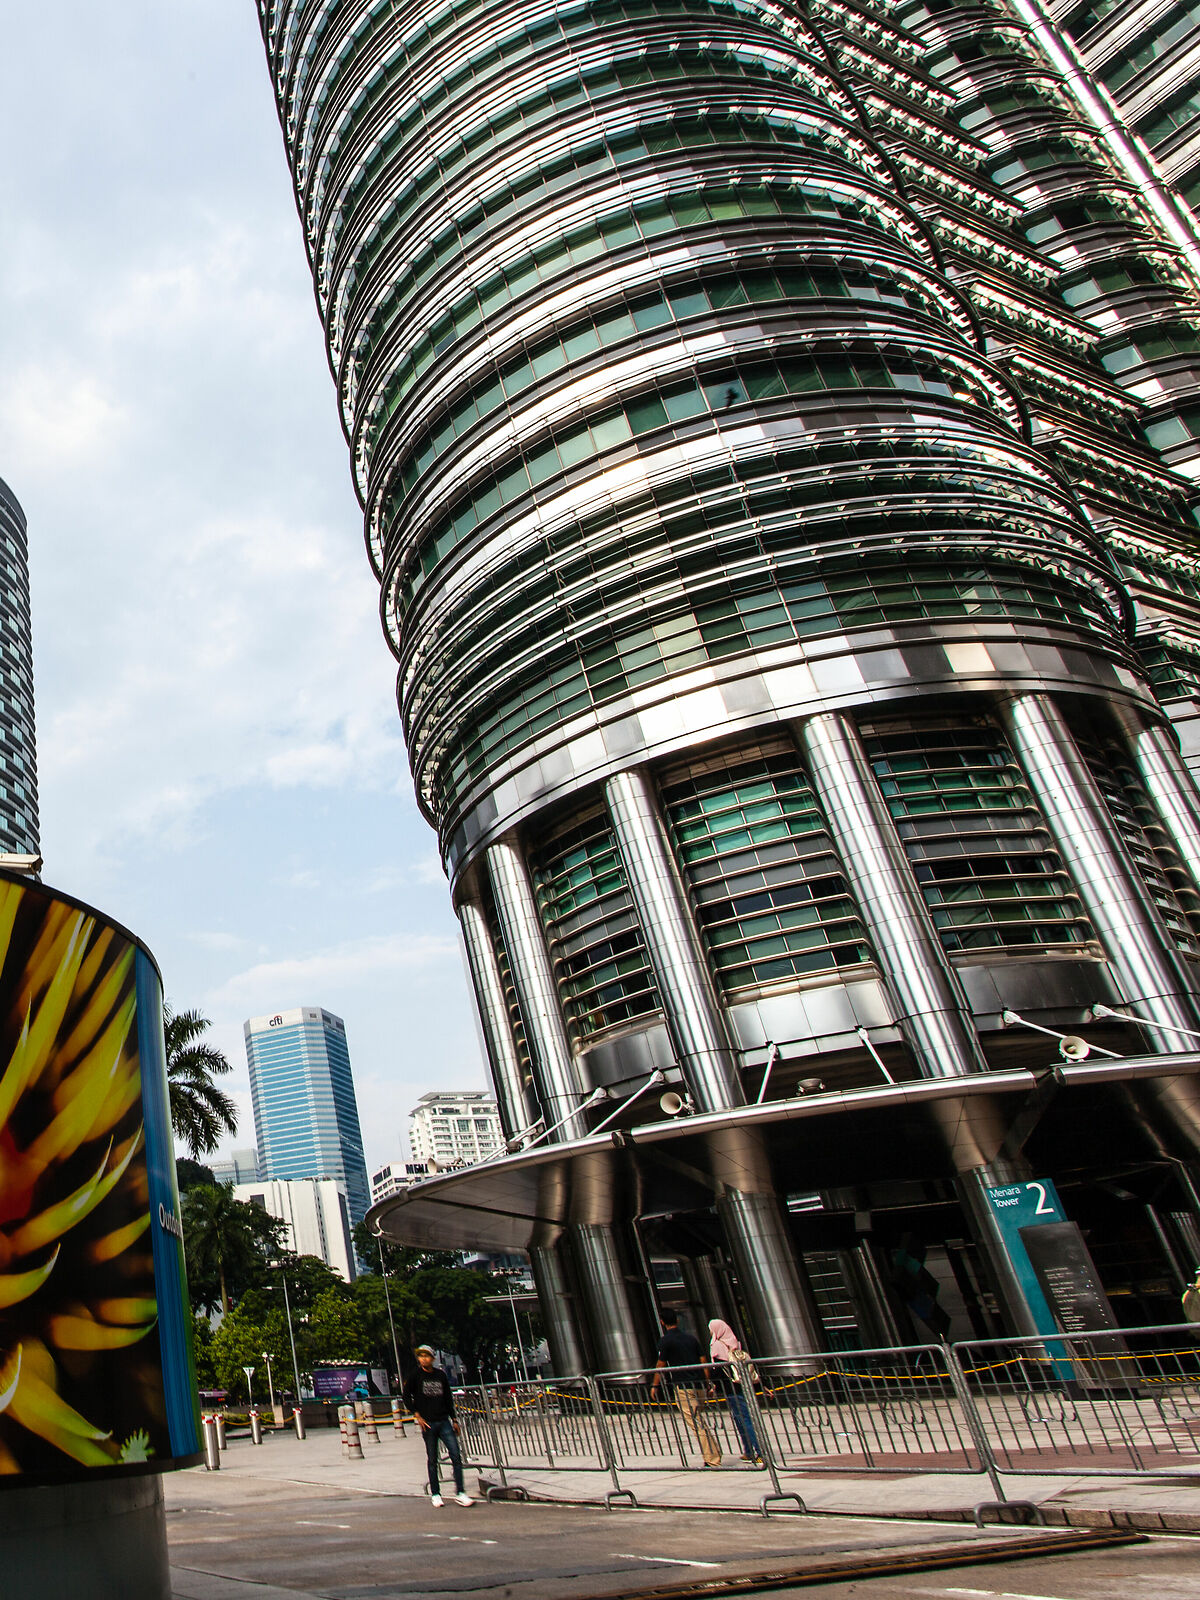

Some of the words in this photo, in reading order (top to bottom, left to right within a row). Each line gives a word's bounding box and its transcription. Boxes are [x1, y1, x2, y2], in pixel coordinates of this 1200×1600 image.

[269, 1015, 283, 1027] citi
[989, 1187, 1021, 1198] Menara
[993, 1198, 1019, 1208] Tower
[1026, 1182, 1055, 1215] 2
